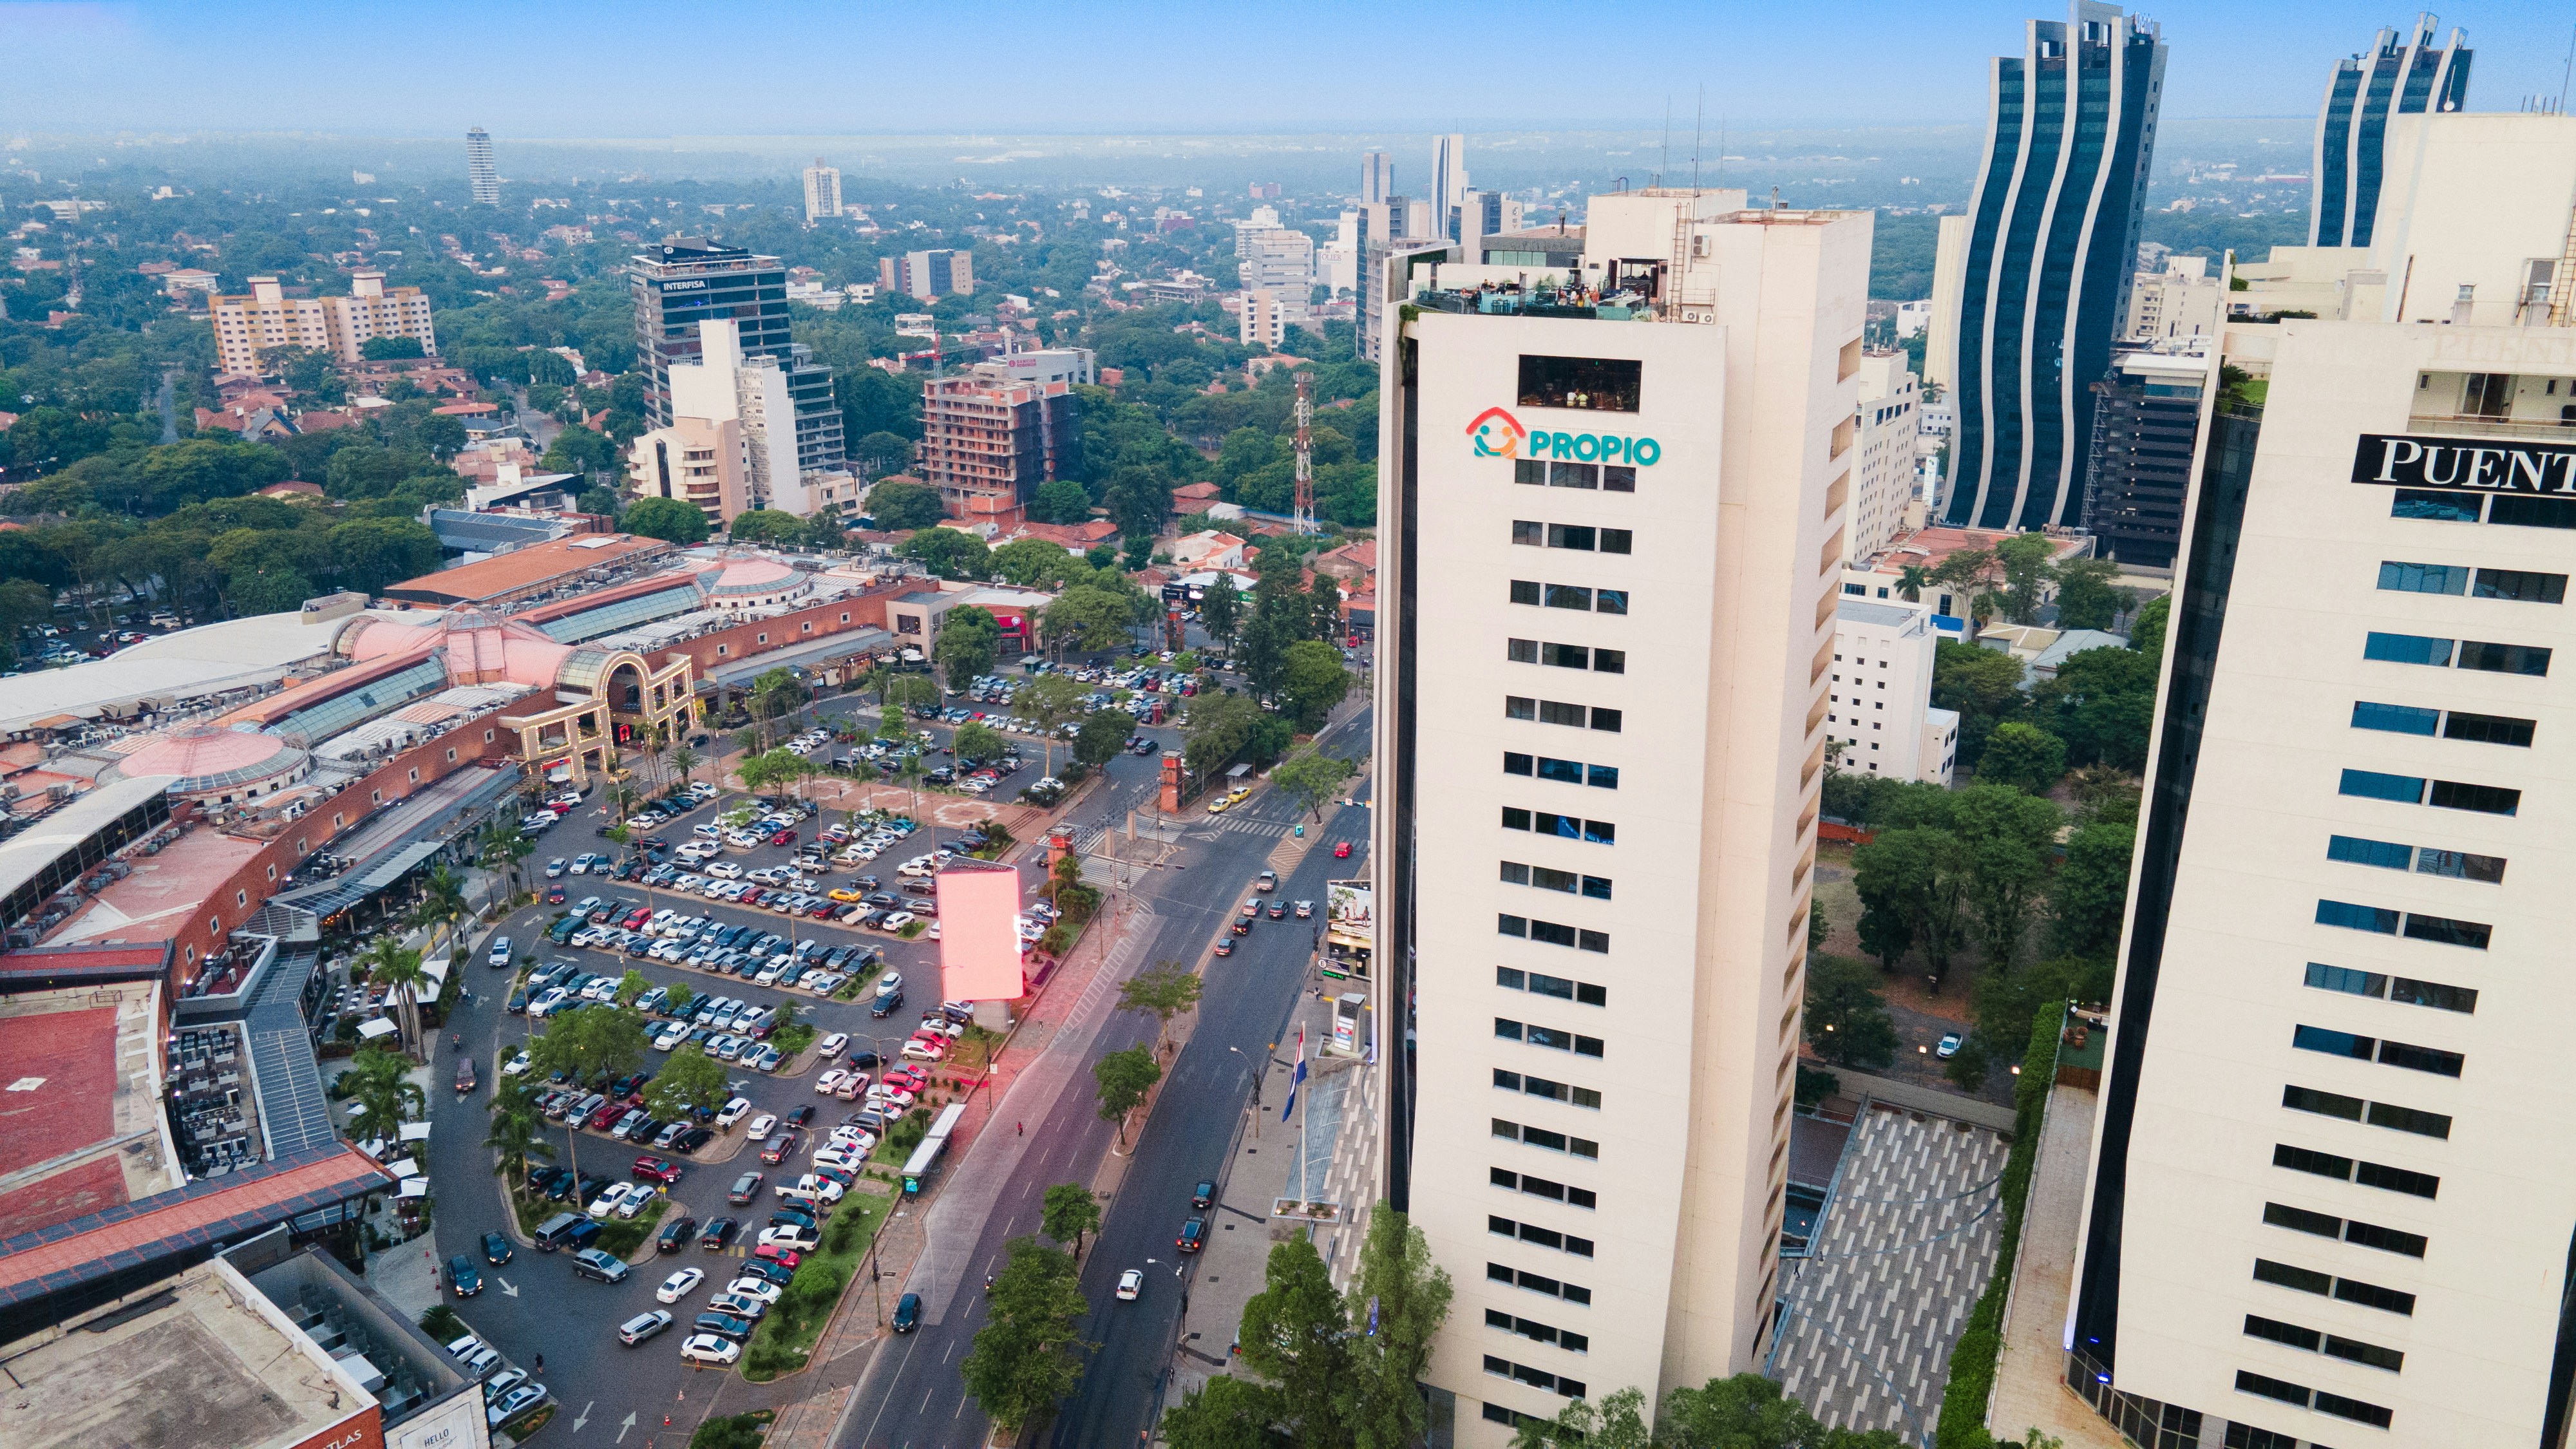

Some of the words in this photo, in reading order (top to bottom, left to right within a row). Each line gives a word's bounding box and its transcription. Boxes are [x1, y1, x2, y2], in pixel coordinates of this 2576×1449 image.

[663, 281, 705, 290] INTERFISA
[1530, 430, 1661, 466] PROPIO
[323, 1428, 362, 1449] TLAS
[424, 1428, 449, 1447] HELLO
